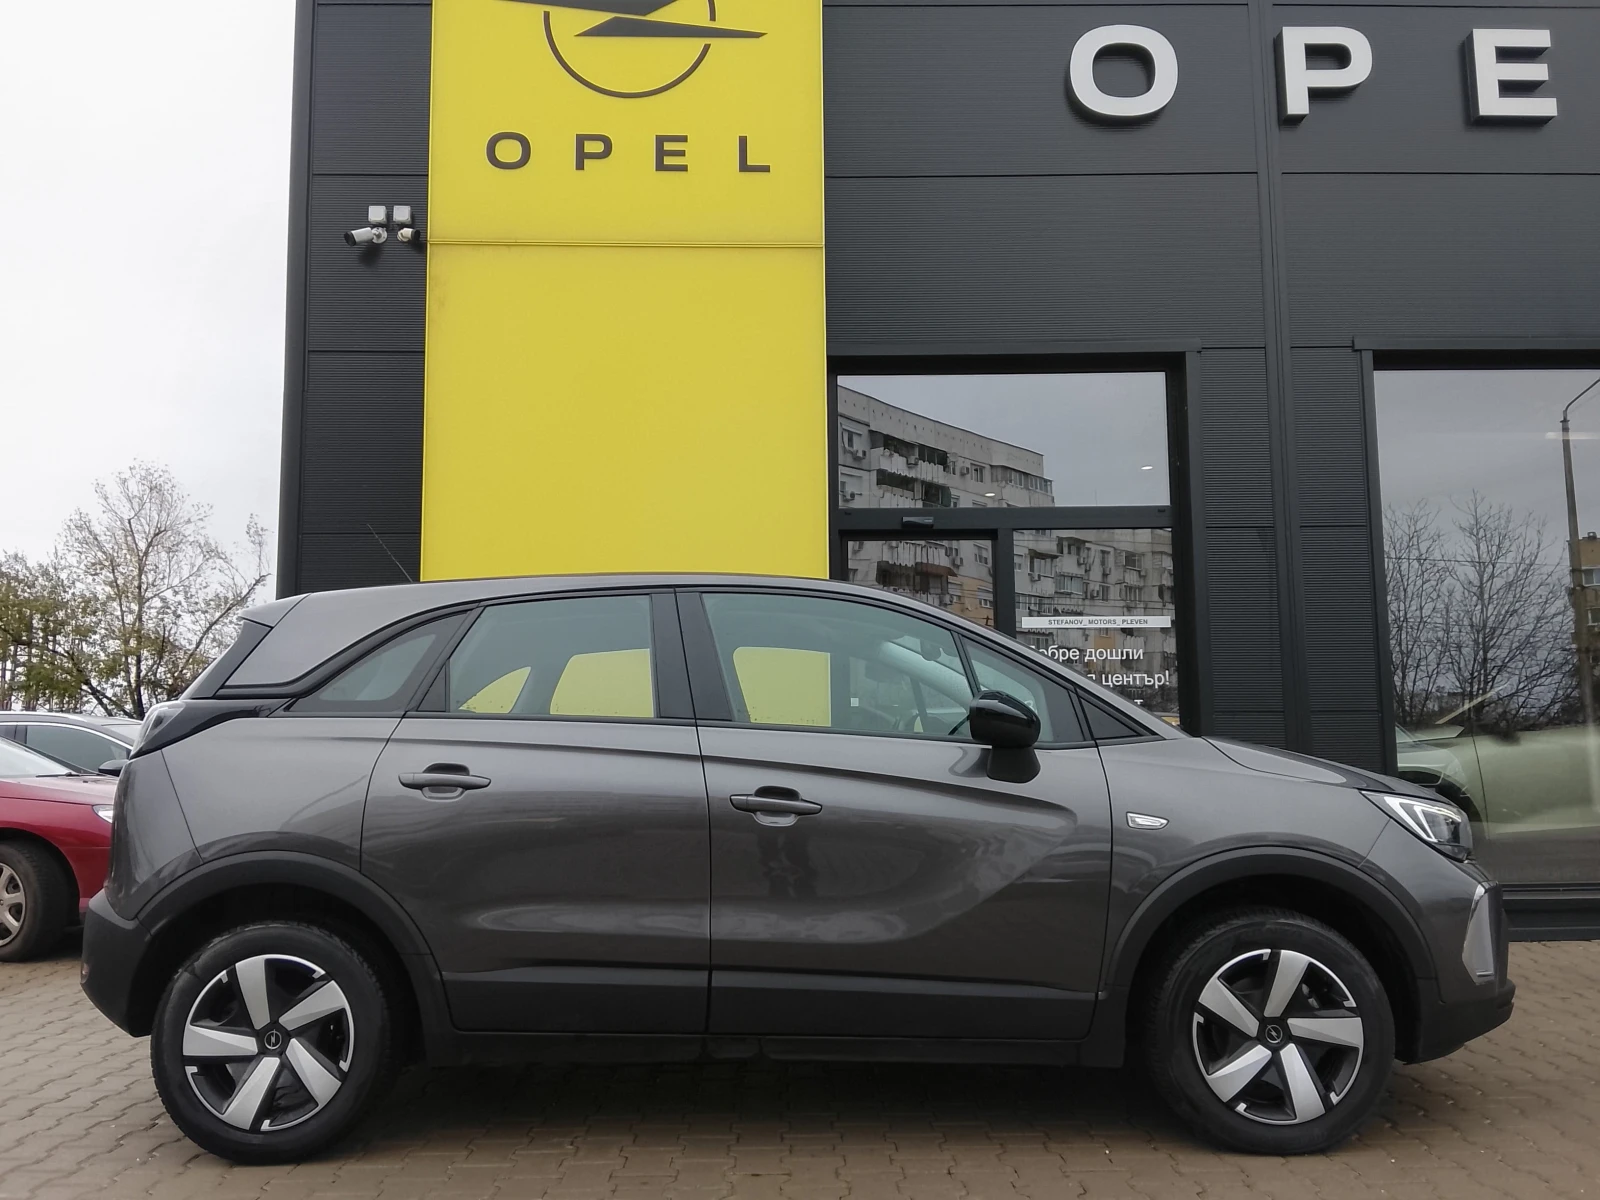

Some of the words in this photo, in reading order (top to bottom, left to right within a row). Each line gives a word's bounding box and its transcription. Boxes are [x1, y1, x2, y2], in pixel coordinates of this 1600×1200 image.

[1068, 24, 1558, 121] OPE
[486, 130, 771, 173] OPEL
[1084, 648, 1144, 662] дошли
[1101, 669, 1170, 689] център!
